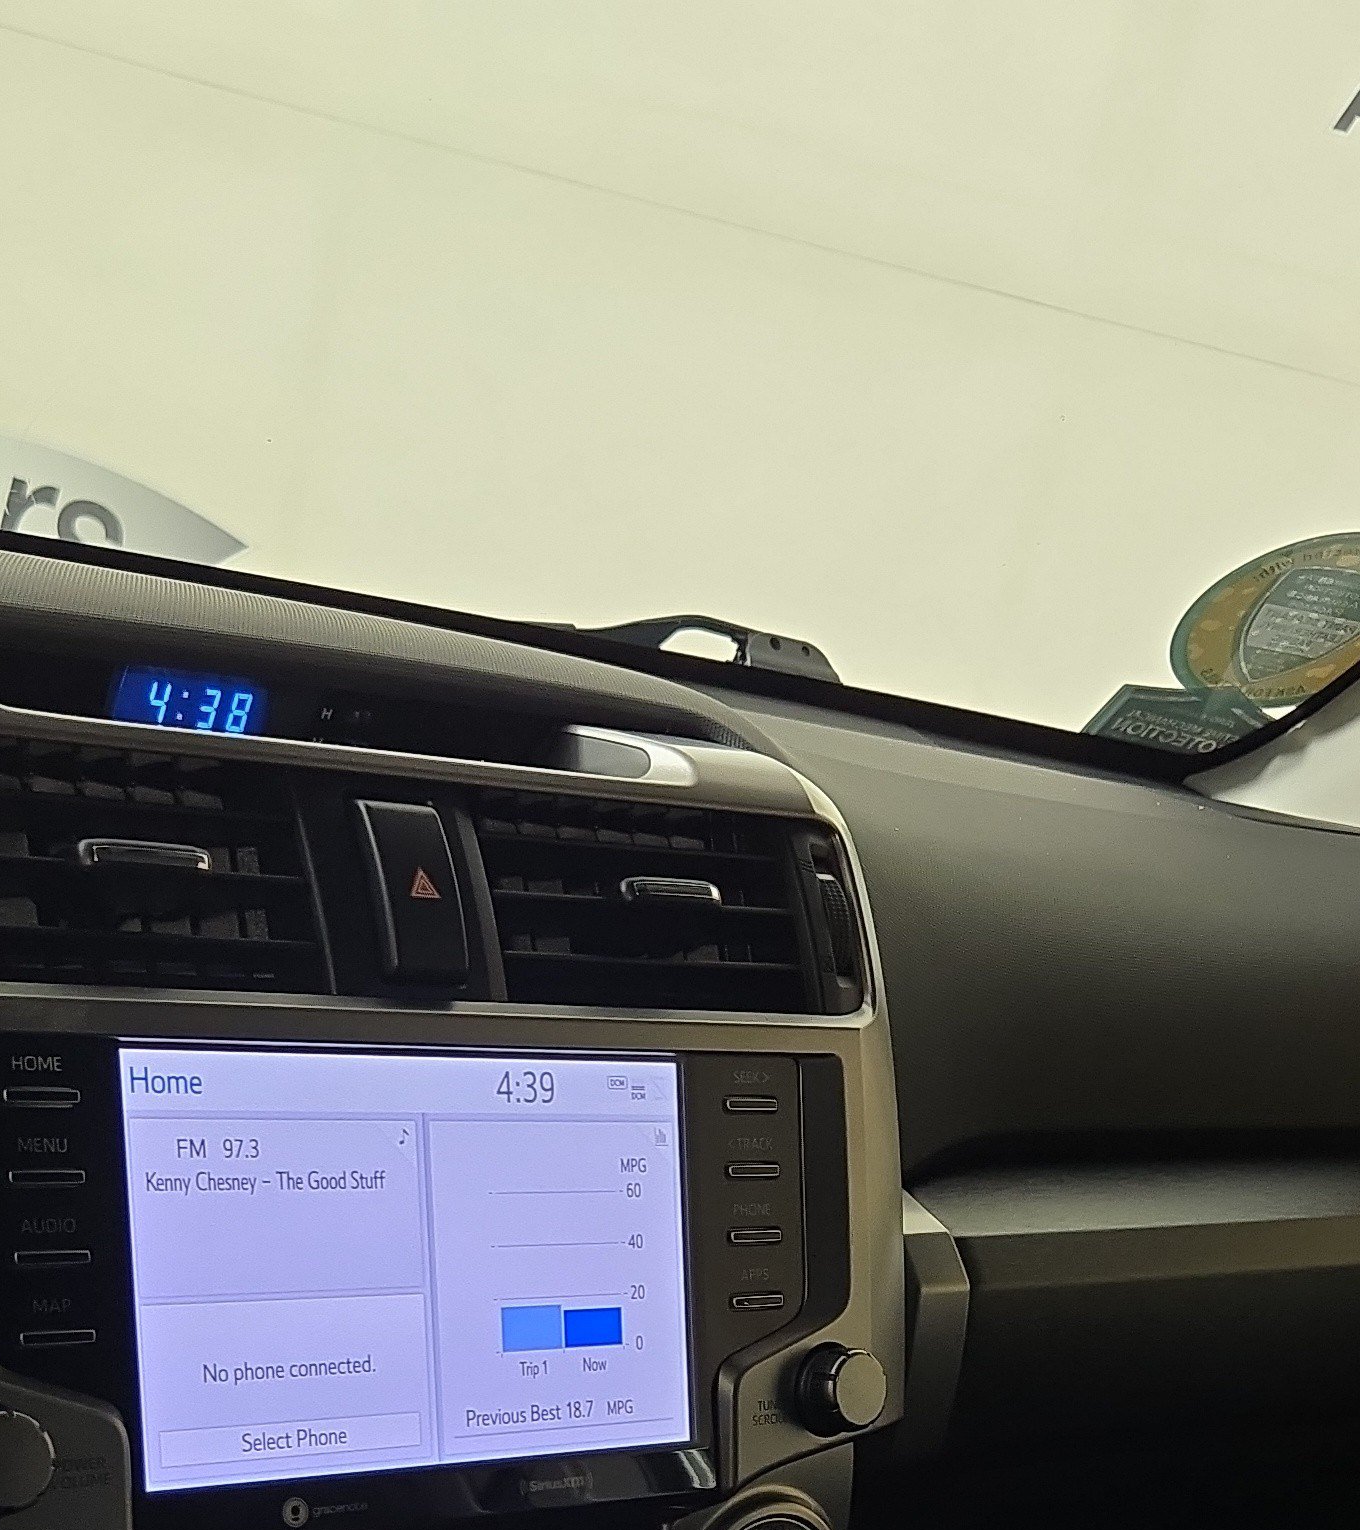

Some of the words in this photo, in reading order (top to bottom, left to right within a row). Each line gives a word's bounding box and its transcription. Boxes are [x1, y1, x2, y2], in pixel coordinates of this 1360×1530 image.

[148, 681, 253, 733] 4:38
[11, 1056, 62, 1072] HOME
[130, 1066, 203, 1095] Home
[496, 1071, 555, 1104] 4:39
[17, 1137, 68, 1154] MENU
[176, 1139, 207, 1159] FM
[223, 1139, 260, 1159] 97.3
[620, 1158, 647, 1174] MPG
[145, 1173, 191, 1196] Kenny
[196, 1172, 257, 1195] Chesney
[276, 1172, 305, 1191] The
[308, 1171, 347, 1191] Good
[348, 1171, 387, 1191] Stuff
[626, 1182, 642, 1198] 60
[20, 1217, 78, 1234] AUDIO
[628, 1234, 644, 1250] 40
[631, 1285, 646, 1300] 20
[636, 1336, 644, 1351] 0
[203, 1363, 229, 1383] No
[234, 1359, 285, 1383] phone
[289, 1355, 377, 1379] connected.
[519, 1361, 539, 1379] Trip
[542, 1361, 549, 1376] 1
[582, 1357, 607, 1373] Now
[466, 1406, 528, 1428] Previous
[530, 1404, 562, 1423] Best
[566, 1401, 594, 1420] 18.7
[607, 1399, 634, 1416] MPG
[241, 1429, 291, 1452] Select
[295, 1427, 348, 1450] Phone
